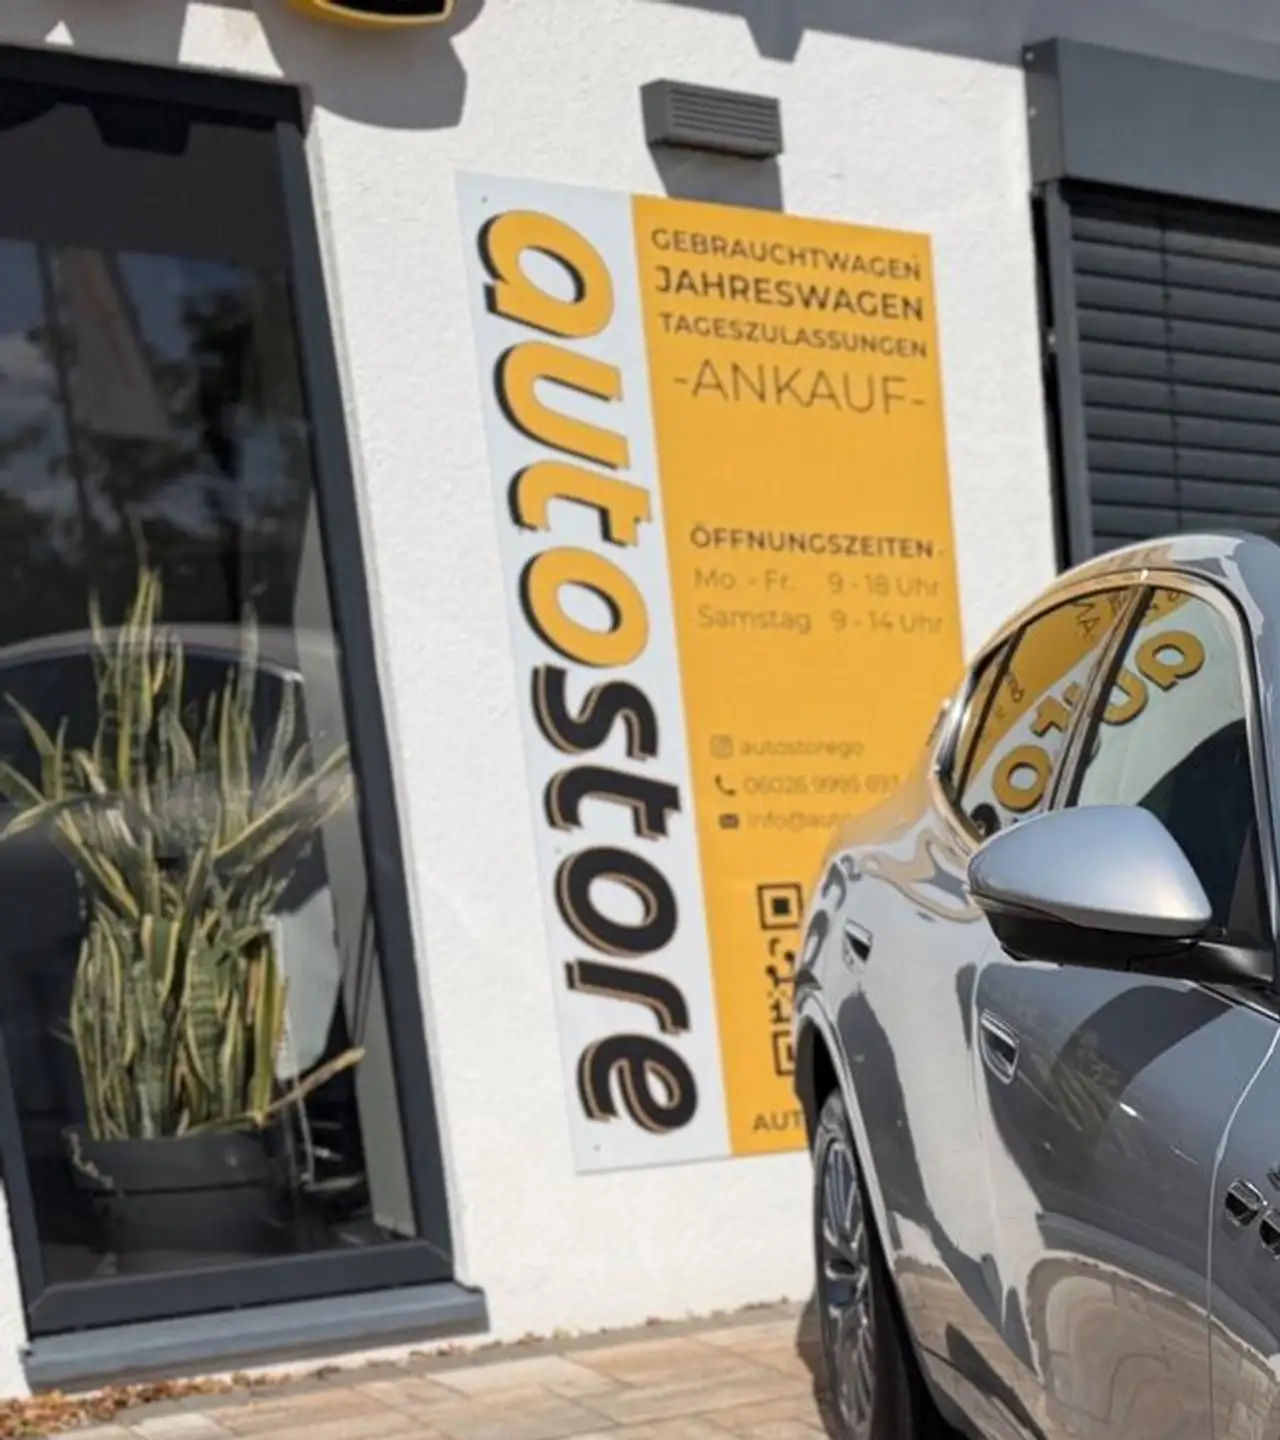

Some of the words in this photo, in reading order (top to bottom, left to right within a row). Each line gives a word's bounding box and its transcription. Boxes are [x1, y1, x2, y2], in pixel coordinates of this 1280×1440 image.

[651, 227, 921, 281] GEBRAUCHTWAGEN
[654, 265, 924, 321] JAHRESWAGEN
[660, 311, 927, 358] TAGESZULASSUNGEN
[690, 525, 934, 559] ÖFFNUNGSZEITEN
[896, 575, 940, 598] Uhr
[697, 604, 812, 635] Samstag
[900, 614, 943, 634] Uhr
[477, 209, 699, 1135] autostore
